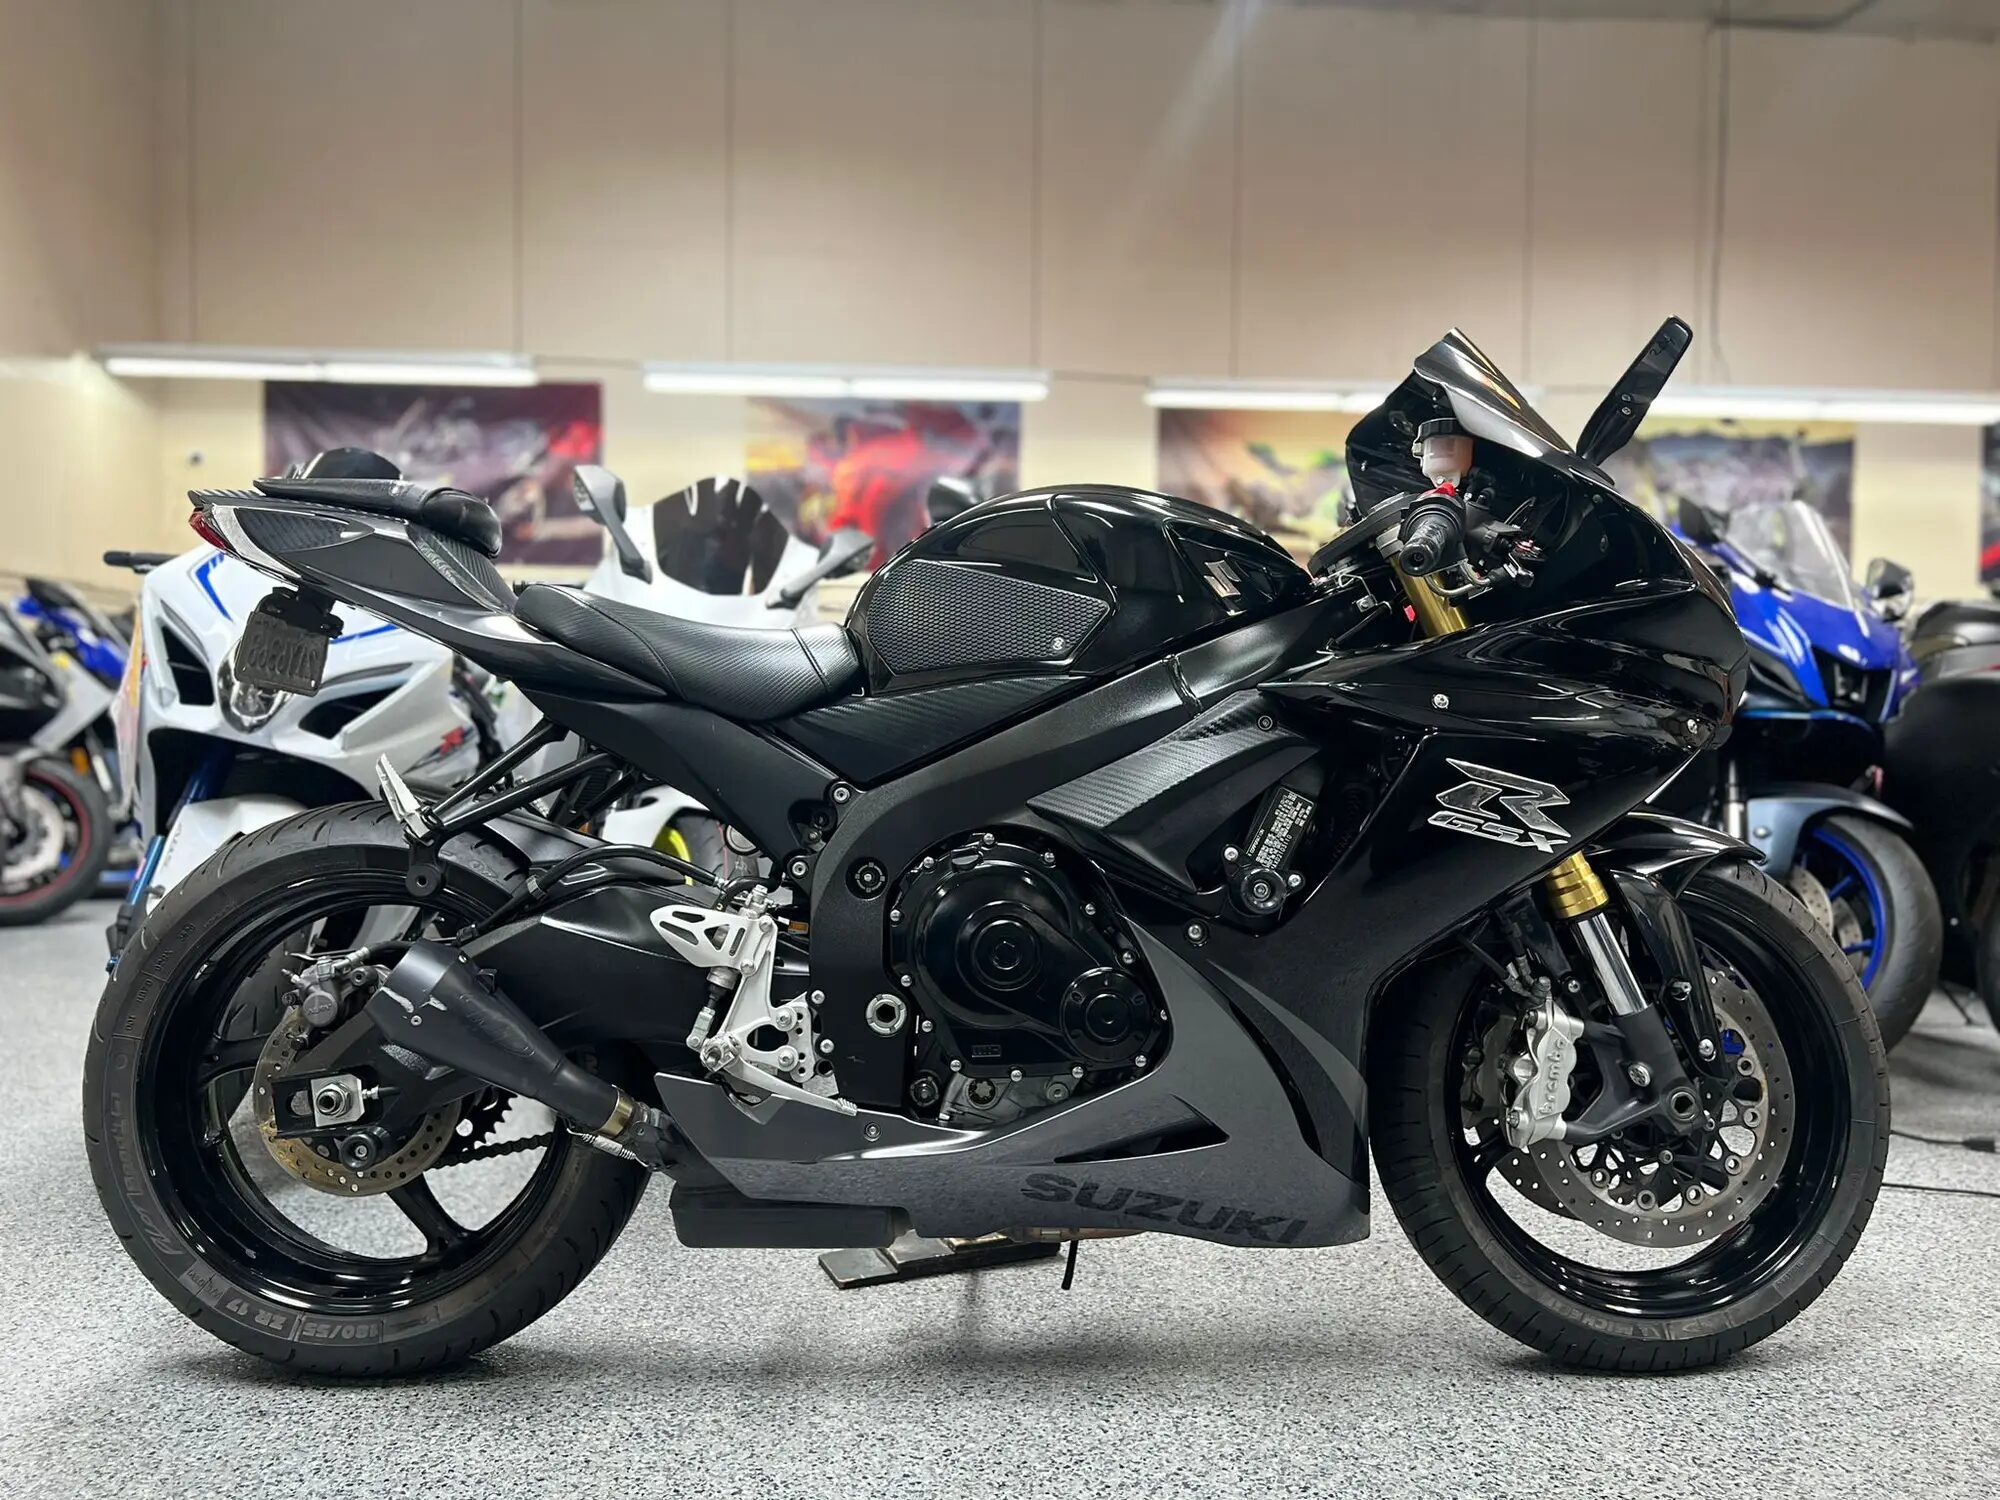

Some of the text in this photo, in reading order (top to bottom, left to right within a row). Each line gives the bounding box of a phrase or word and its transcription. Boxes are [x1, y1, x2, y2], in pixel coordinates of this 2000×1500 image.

[1427, 810, 1569, 853] GSX
[1538, 1039, 1569, 1114] brembo
[1020, 1173, 1308, 1243] SUZUKI
[226, 1298, 250, 1316] 17
[254, 1309, 287, 1330] ZR
[302, 1322, 379, 1340] 180/55
